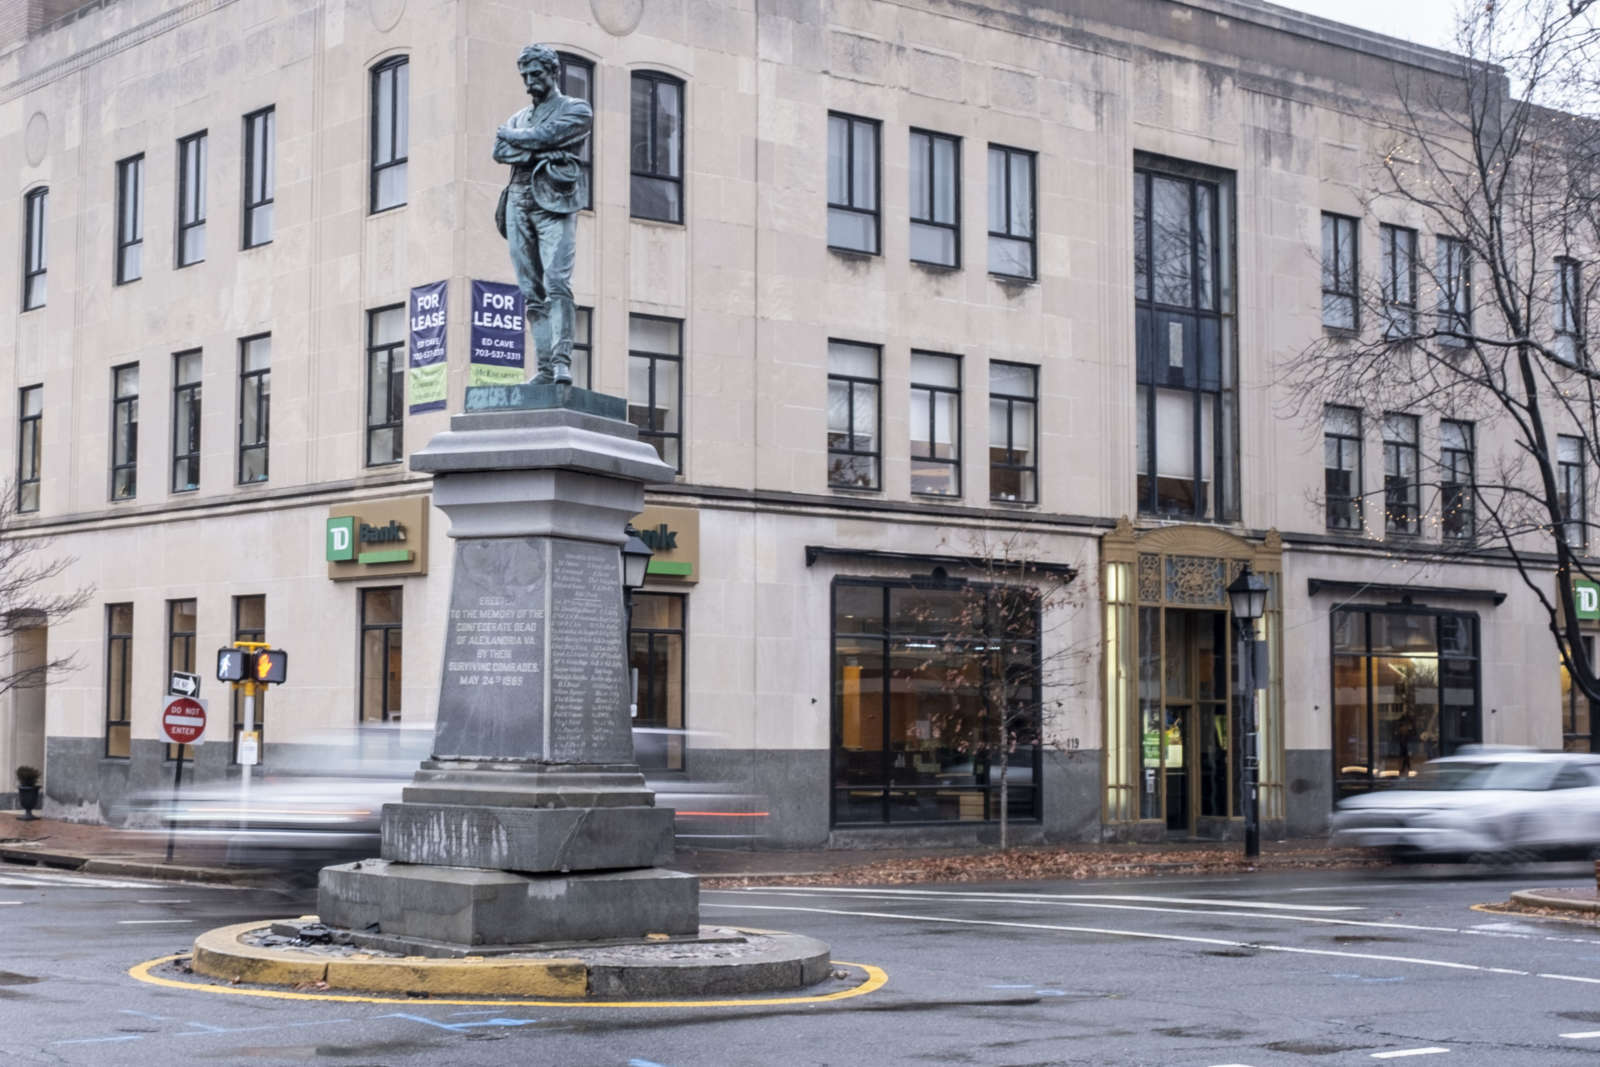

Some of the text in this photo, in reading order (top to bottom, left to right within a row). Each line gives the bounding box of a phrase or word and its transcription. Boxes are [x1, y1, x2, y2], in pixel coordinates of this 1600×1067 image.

[417, 293, 439, 311] FOR
[483, 292, 514, 311] FOR
[412, 311, 445, 332] LEASE
[474, 311, 522, 331] LEASE
[481, 338, 514, 349] ED CAVE
[330, 520, 405, 551] TD Bank
[1576, 586, 1598, 612] TD
[450, 609, 545, 619] TO THE MEMORY OF THE
[456, 622, 537, 632] CONFEDERATE DEAD
[456, 635, 467, 645] OF
[468, 635, 522, 645] ALEXANDRIA
[448, 662, 491, 672] SURVIVING
[459, 675, 479, 685] MAY
[171, 706, 200, 716] DO NOT
[171, 726, 196, 736] ENTER
